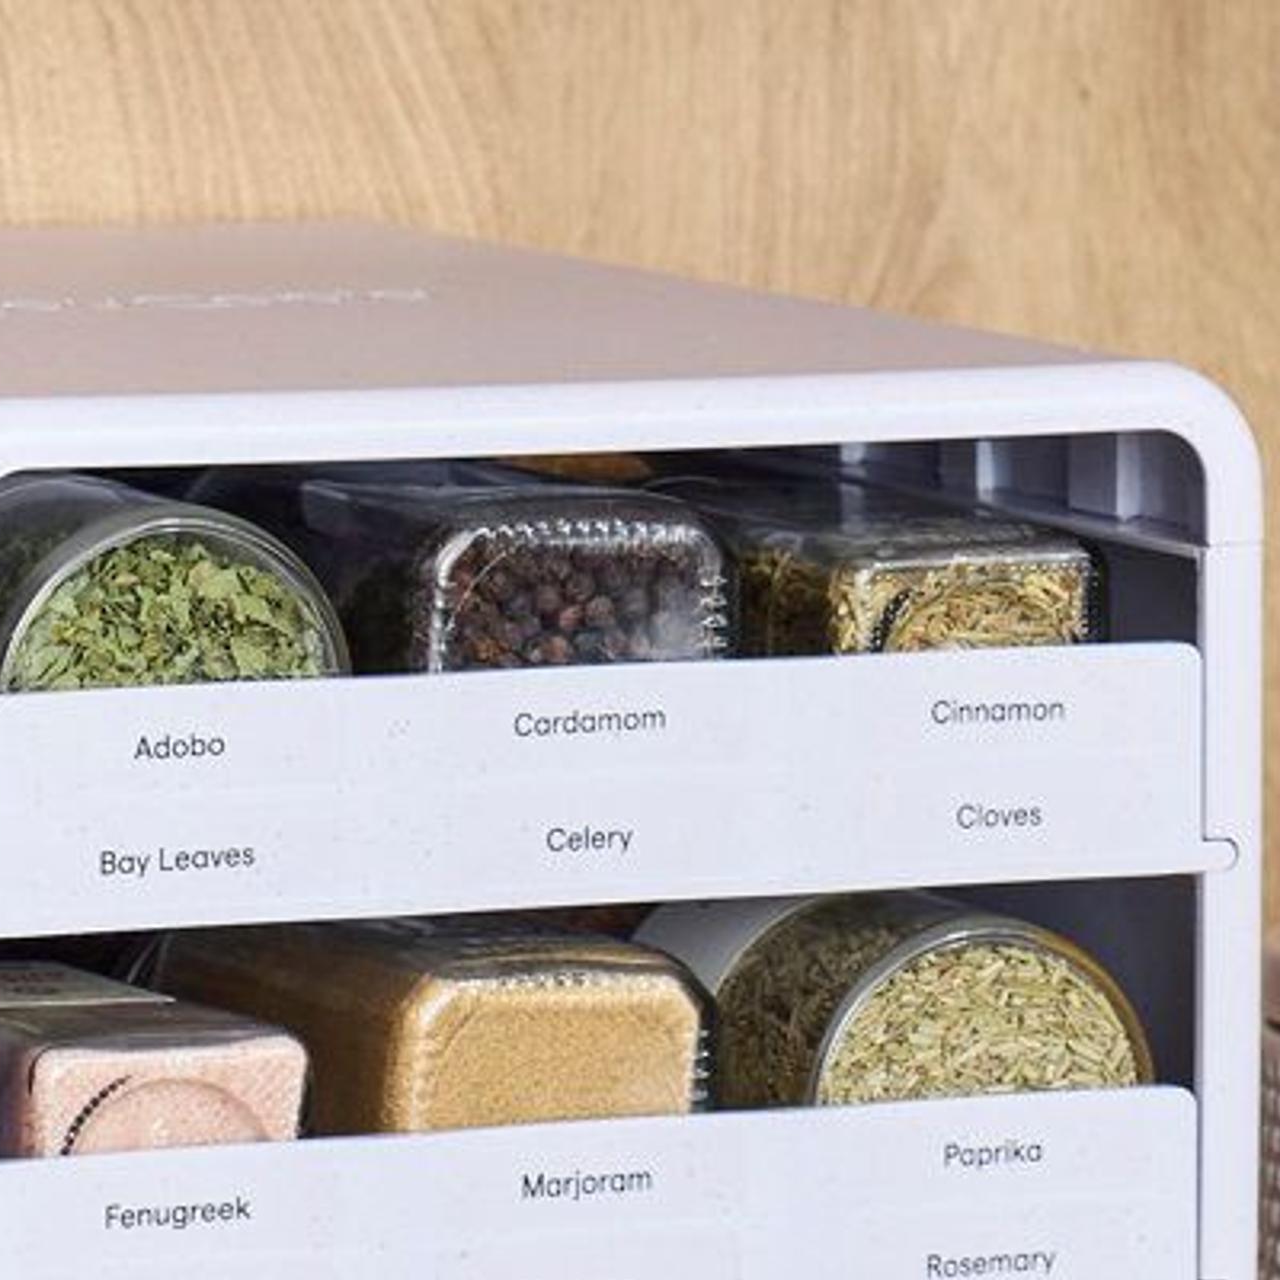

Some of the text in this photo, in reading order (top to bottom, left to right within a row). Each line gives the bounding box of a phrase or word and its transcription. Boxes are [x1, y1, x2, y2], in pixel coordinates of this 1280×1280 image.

[513, 710, 667, 738] Cardamom
[930, 699, 1066, 725] Cinnamon
[133, 733, 227, 760] Adobo
[956, 803, 1043, 830] Cloves
[546, 825, 635, 857] Celery
[99, 847, 257, 878] Bay Leaves
[943, 1142, 1044, 1168] Paprika
[522, 1170, 652, 1201] Marjoram
[105, 1196, 252, 1230] Fenugreek
[926, 1251, 1057, 1279] Rosemary
